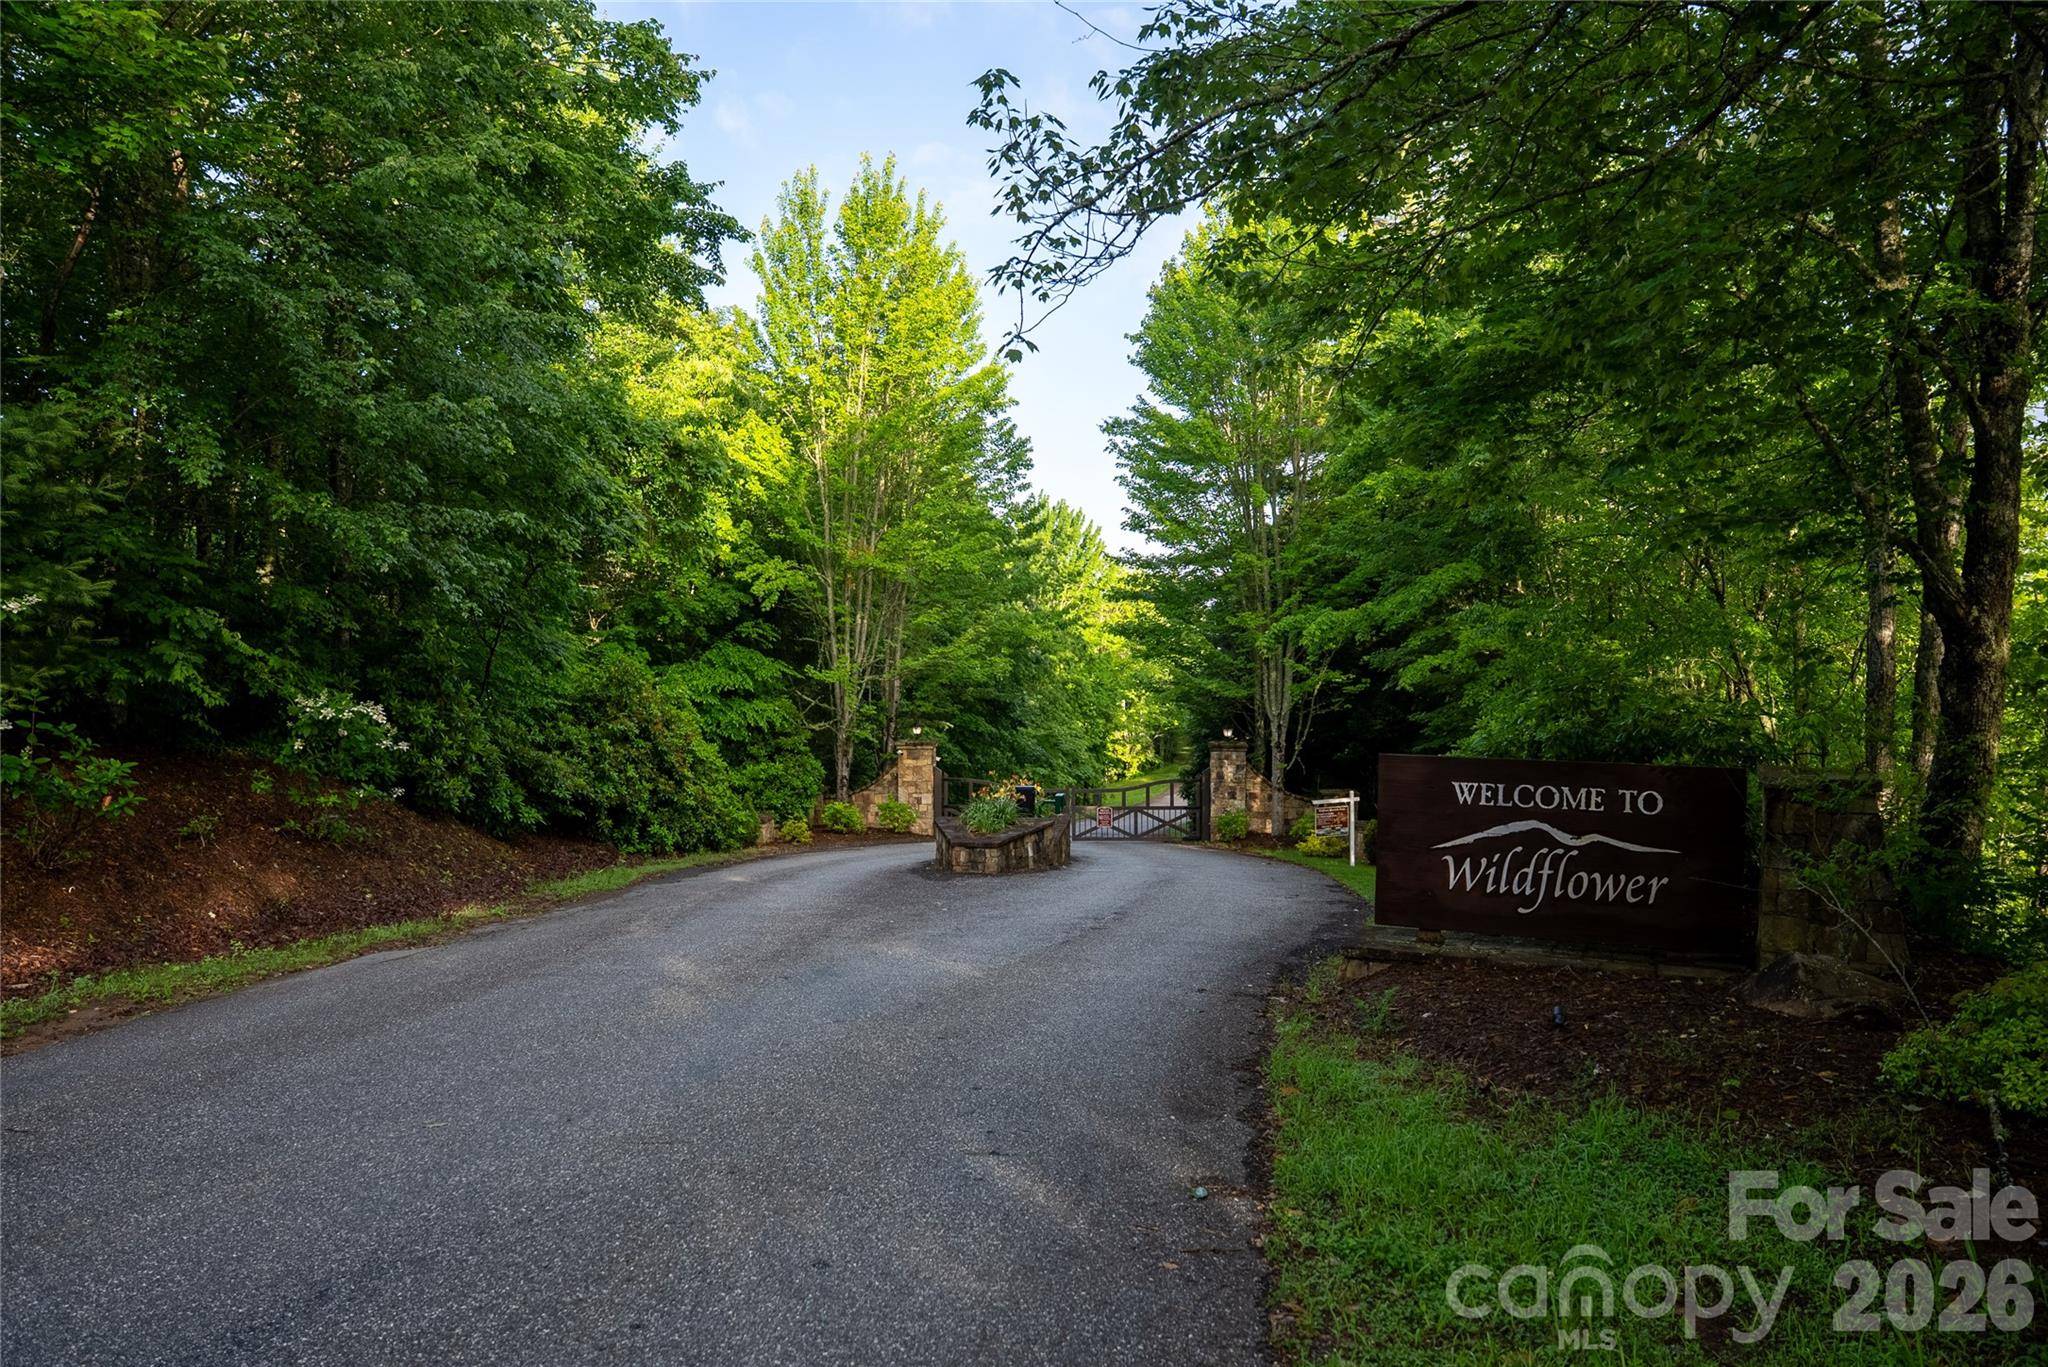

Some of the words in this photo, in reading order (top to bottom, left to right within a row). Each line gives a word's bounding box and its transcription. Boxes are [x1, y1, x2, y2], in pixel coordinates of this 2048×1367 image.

[1451, 781, 1605, 812] WELCOME
[1618, 790, 1664, 815] TO
[1441, 846, 1669, 913] Wildflower
